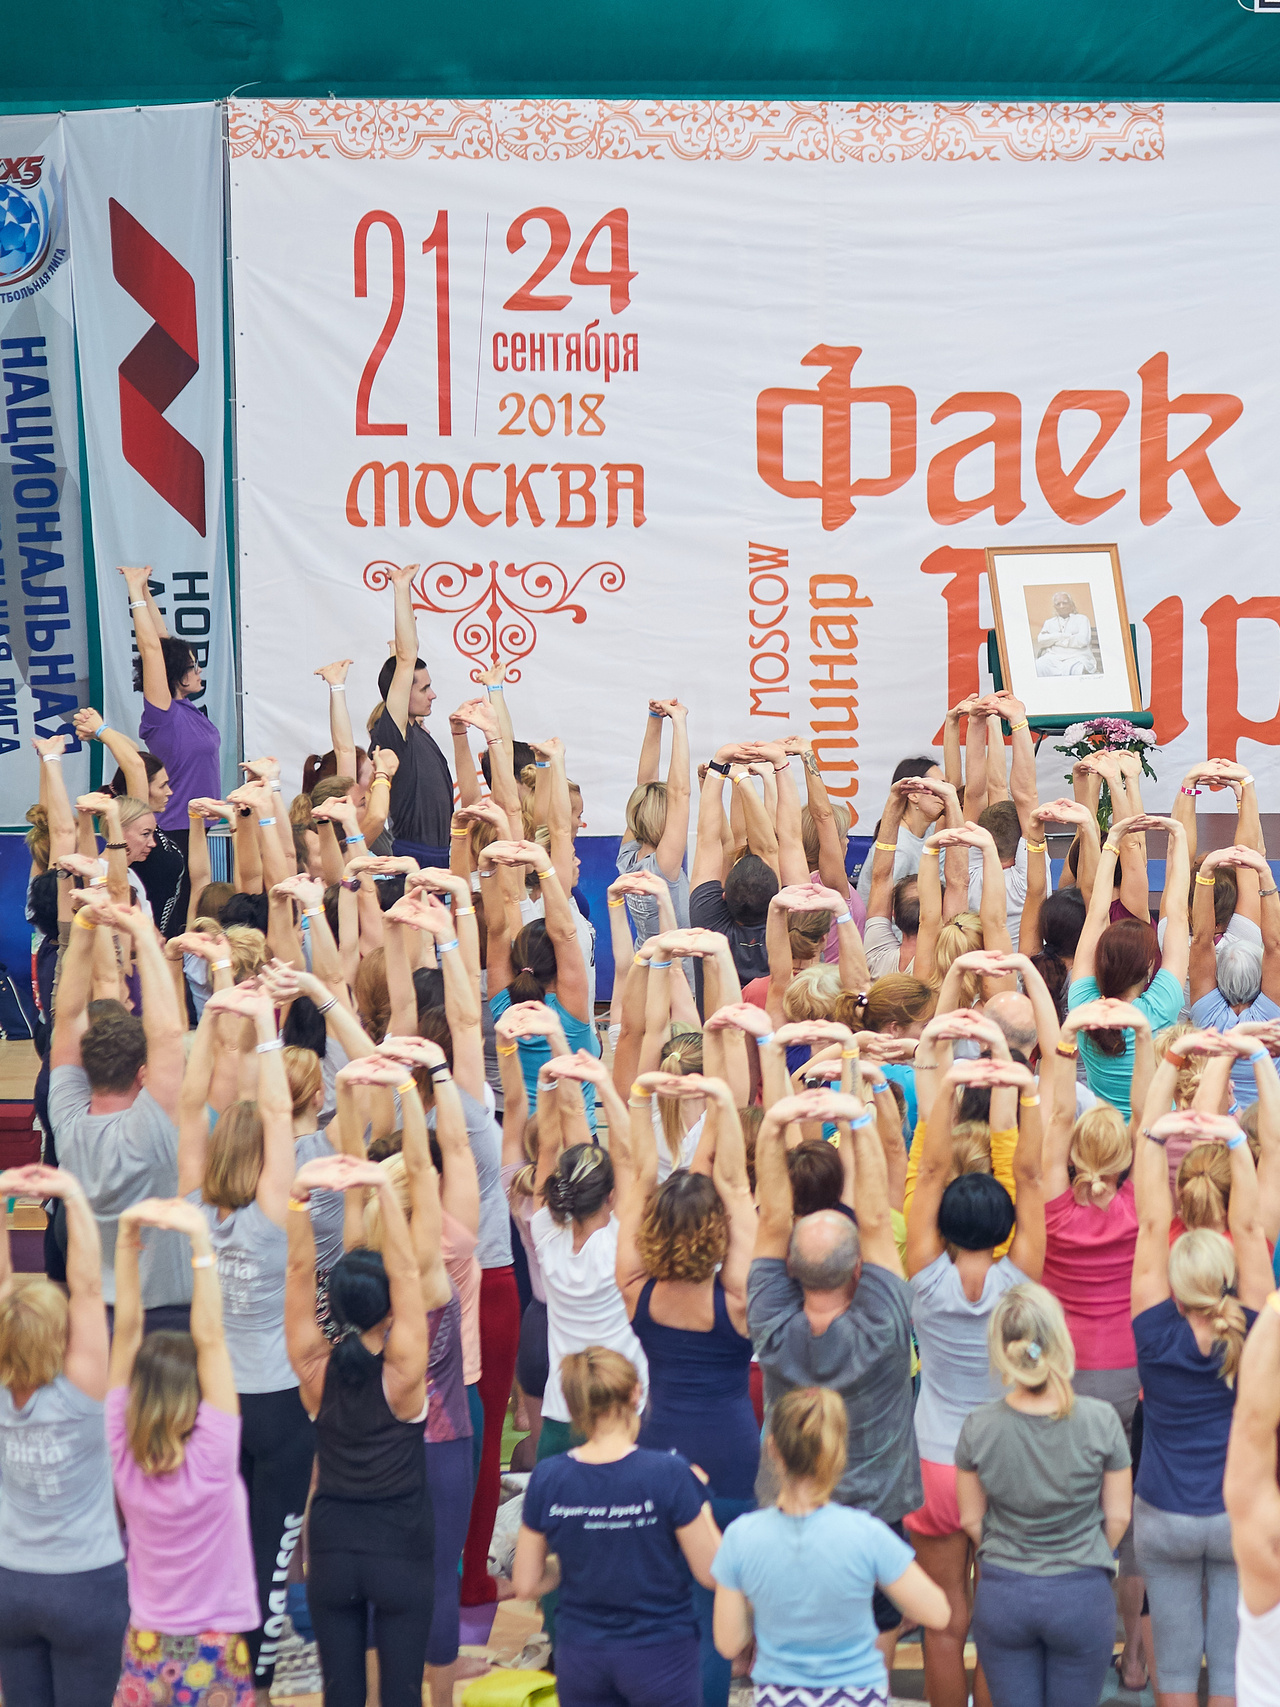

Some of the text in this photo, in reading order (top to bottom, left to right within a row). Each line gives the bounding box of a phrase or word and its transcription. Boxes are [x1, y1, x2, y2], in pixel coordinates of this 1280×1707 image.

[47, 248, 66, 275] ЛИГА
[502, 205, 639, 315] 24
[353, 208, 451, 437] 21
[492, 319, 640, 383] сентября
[496, 392, 606, 437] 2018
[756, 343, 1245, 532] Фаек
[0, 336, 83, 755] НАЦИОНАЛЬНАЯ
[345, 460, 647, 529] МОСКВА
[748, 538, 791, 720] MOSCOW
